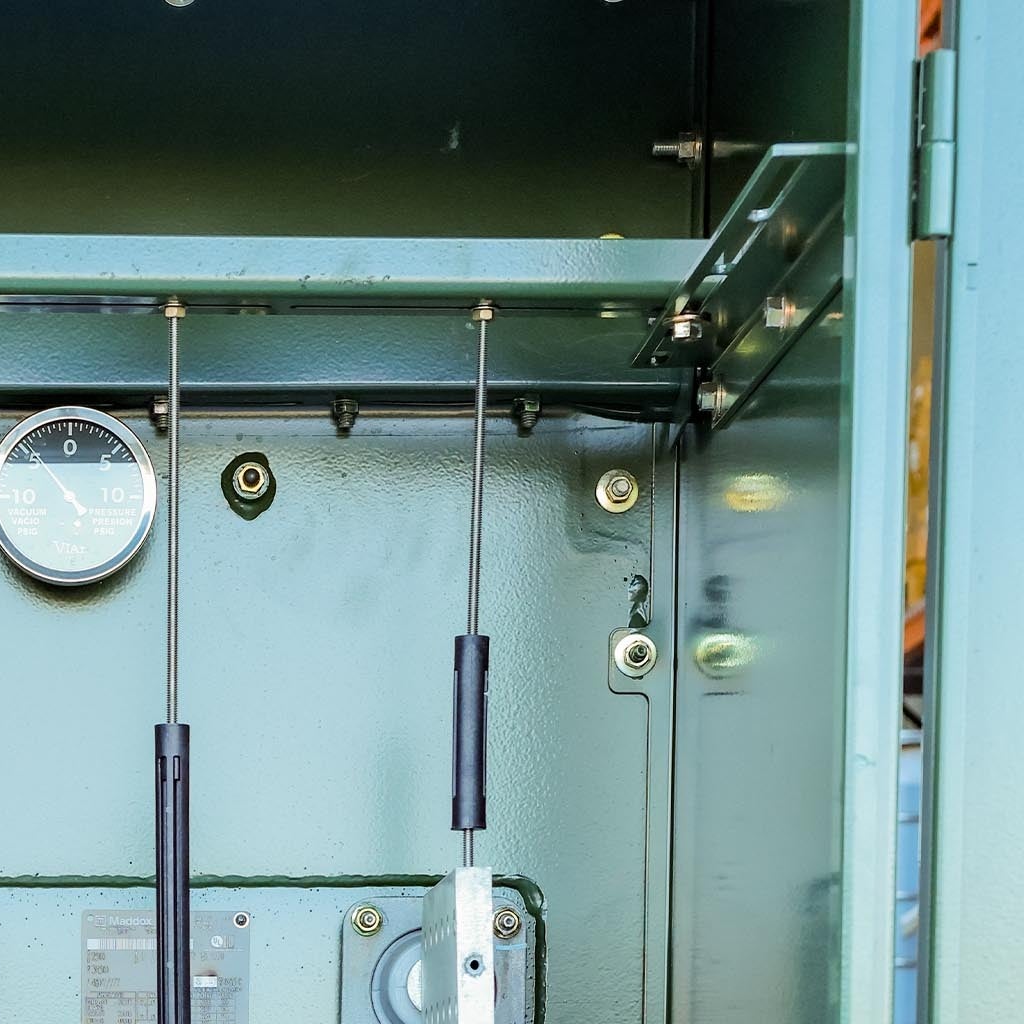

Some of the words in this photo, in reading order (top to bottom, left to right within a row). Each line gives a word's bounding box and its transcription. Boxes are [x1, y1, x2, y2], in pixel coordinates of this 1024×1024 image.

[63, 439, 77, 456] 0
[28, 453, 41, 470] 5
[99, 454, 112, 472] 5
[12, 488, 36, 505] 10
[101, 487, 124, 503] 10
[9, 507, 47, 517] VACUUM
[88, 508, 137, 517] PRESSURE
[17, 527, 38, 536] PSIG
[94, 527, 115, 536] PSIG
[109, 916, 152, 926] Maddox
